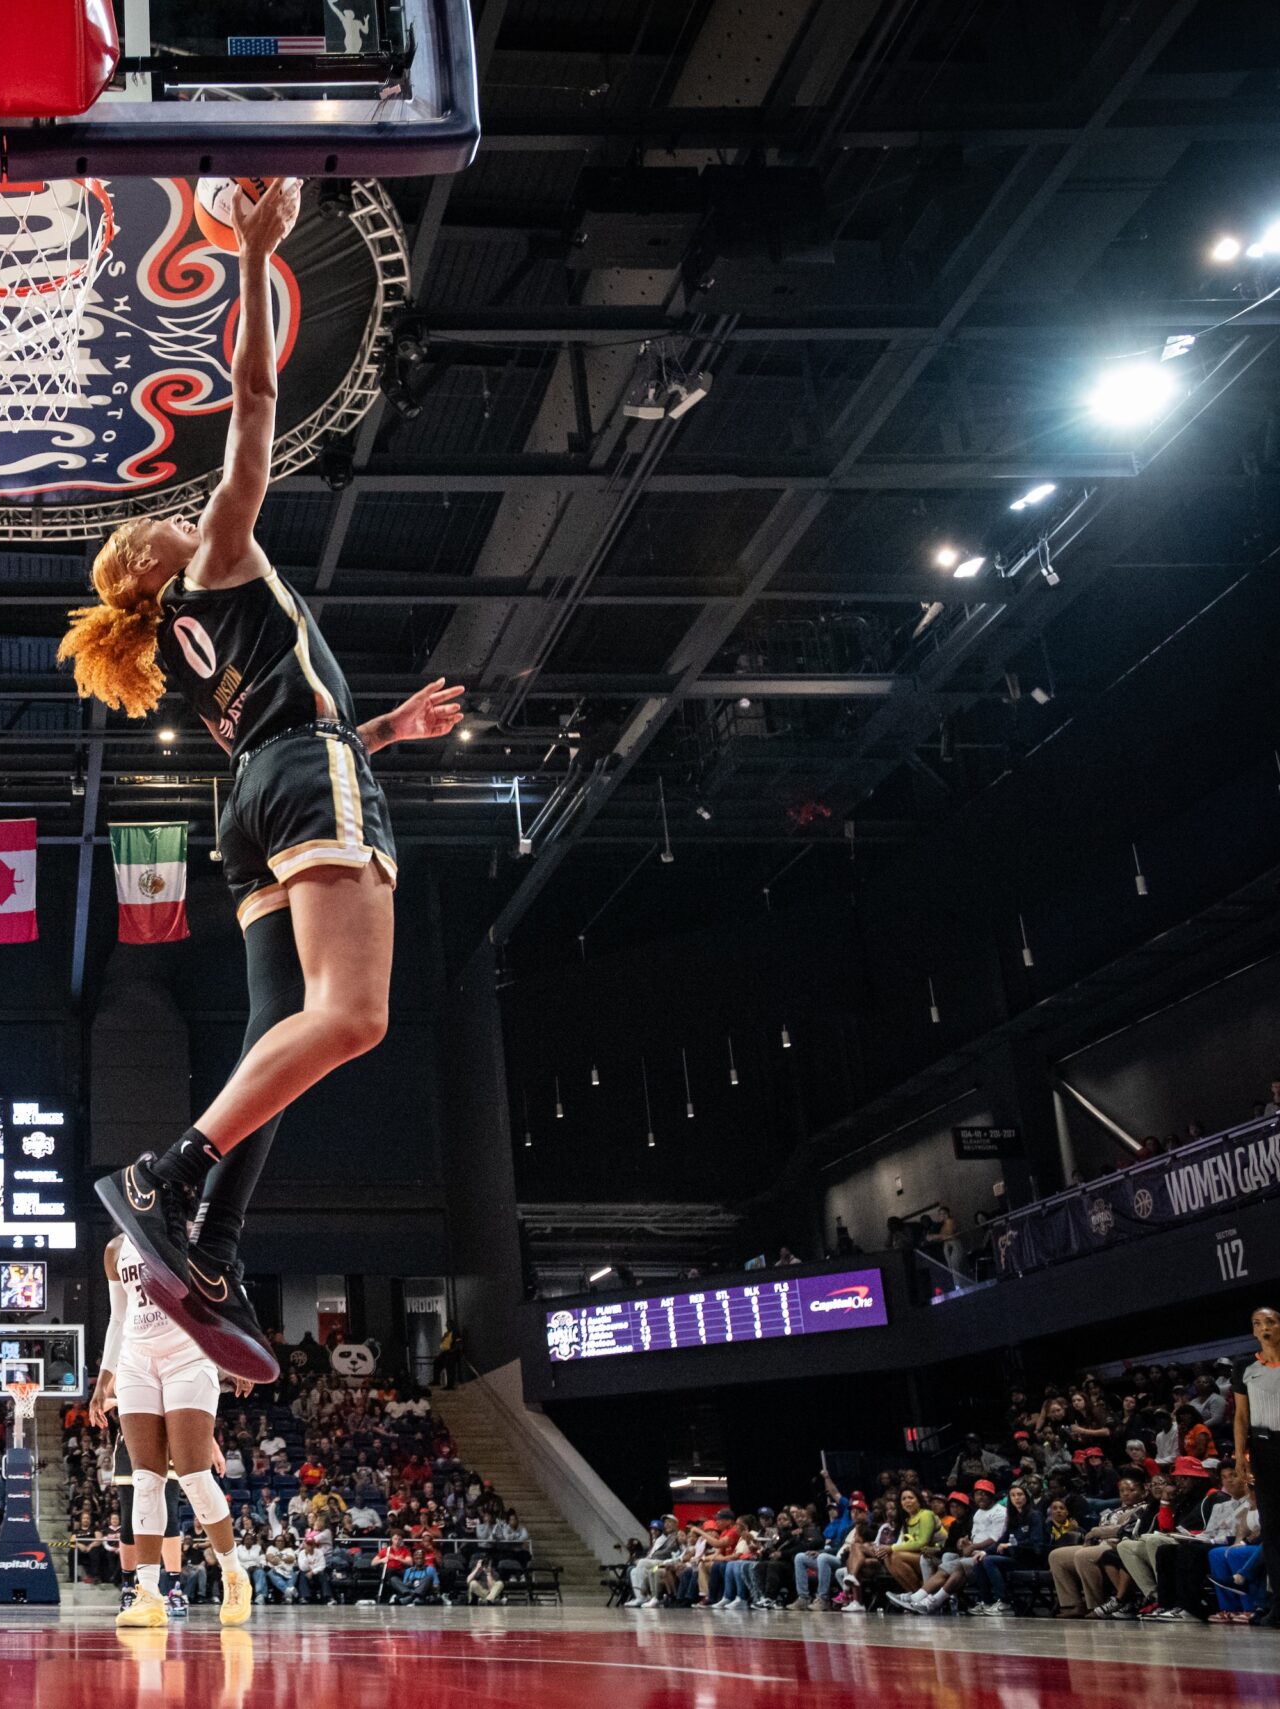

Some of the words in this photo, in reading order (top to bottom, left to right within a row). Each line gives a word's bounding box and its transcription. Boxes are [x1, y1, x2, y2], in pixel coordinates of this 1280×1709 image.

[92, 178, 129, 464] SHINGTON
[174, 616, 216, 679] 0
[1165, 1152, 1237, 1216] WOMEN
[13, 1236, 23, 1248] 2
[34, 1236, 45, 1248] 3
[1217, 1239, 1248, 1282] 112
[596, 1304, 622, 1316] PLAYER
[634, 1301, 648, 1311] PTS
[661, 1297, 674, 1307] AST
[689, 1294, 705, 1304] REB
[716, 1290, 730, 1300] STL
[744, 1286, 760, 1297] BLK
[774, 1282, 789, 1293] FLS
